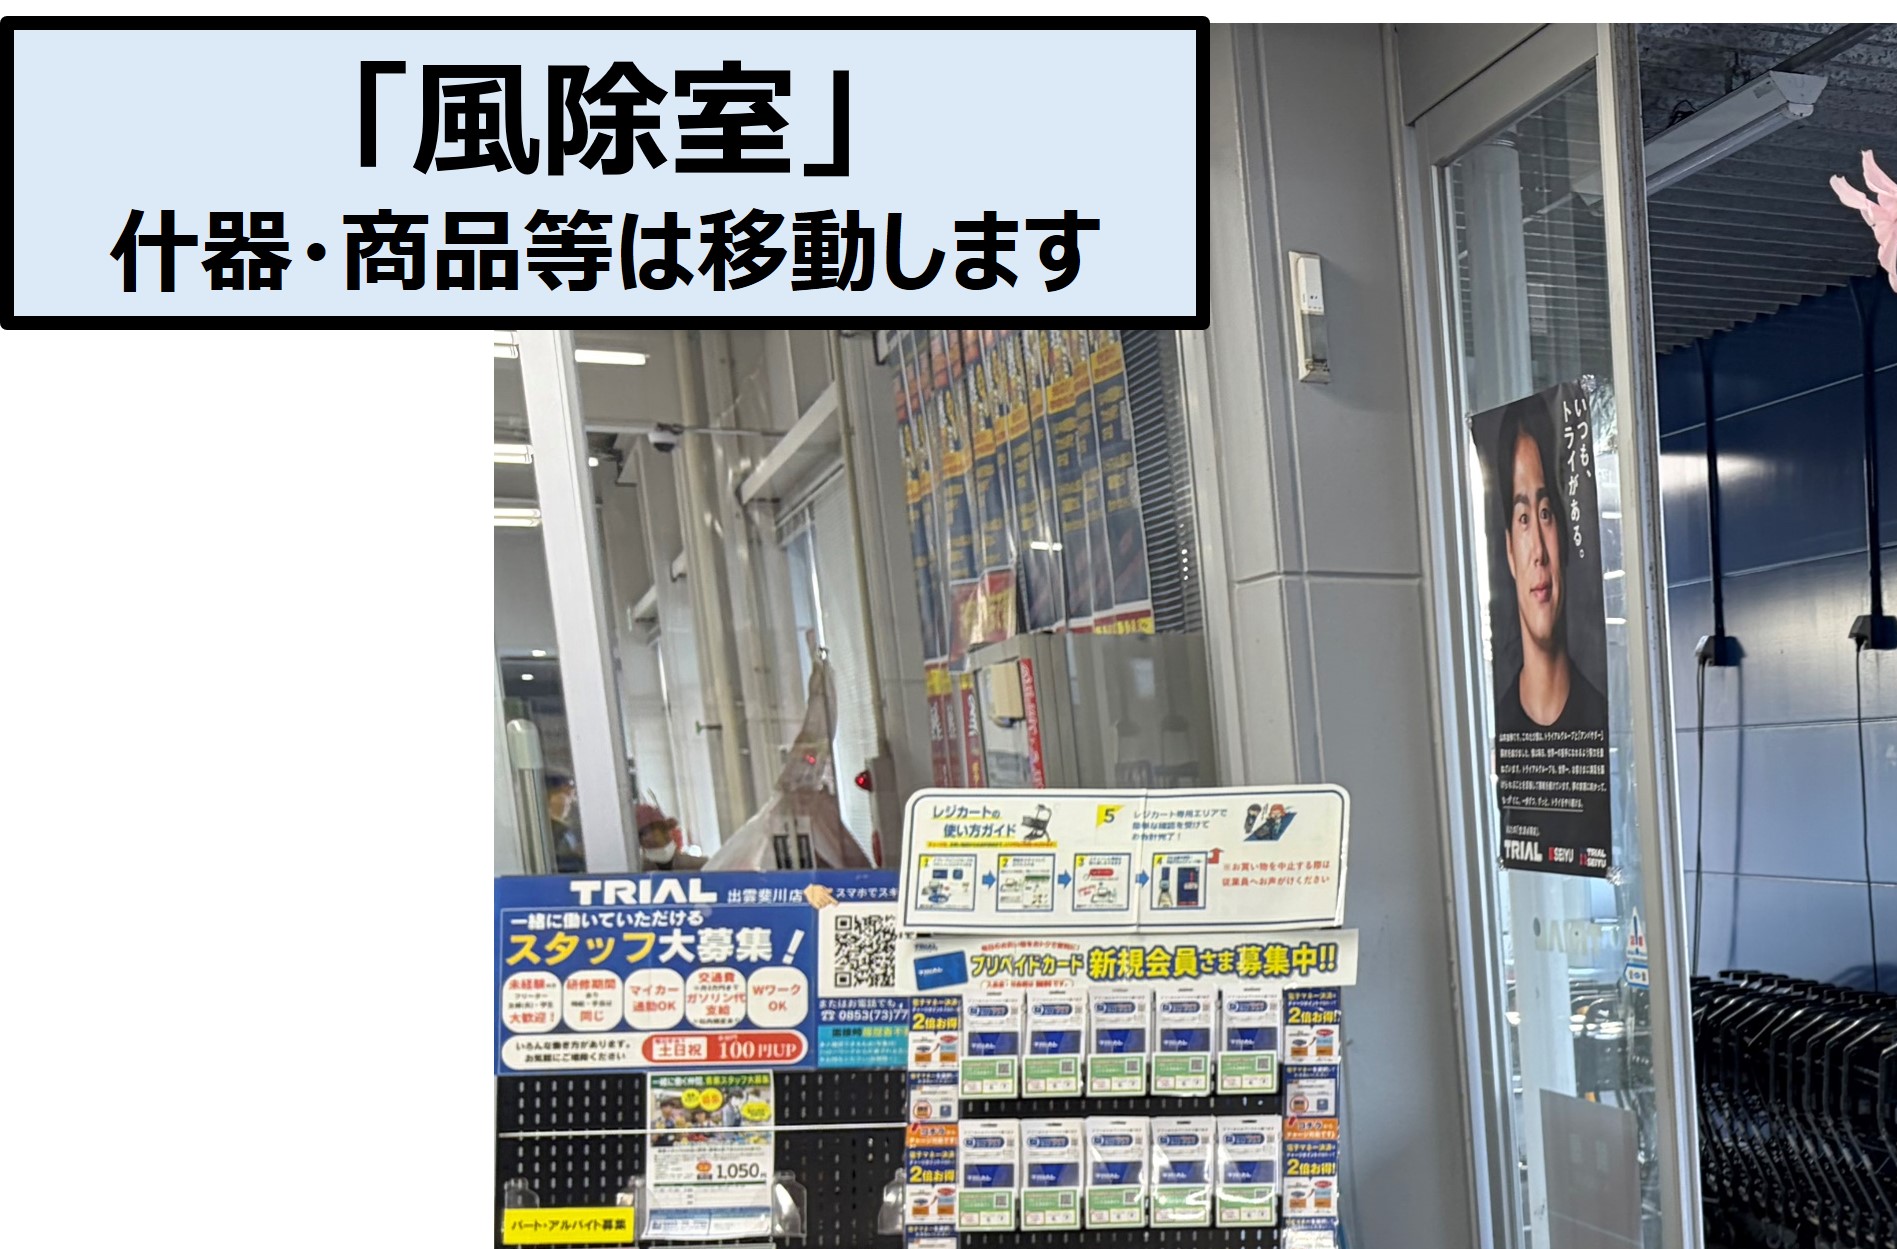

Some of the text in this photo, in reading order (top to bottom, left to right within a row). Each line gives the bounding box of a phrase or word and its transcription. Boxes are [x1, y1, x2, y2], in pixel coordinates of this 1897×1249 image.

[1574, 398, 1592, 478] いつも、
[1563, 401, 1585, 559] トライがある。
[933, 805, 1000, 820] レジカートの
[1105, 808, 1115, 822] 5
[944, 824, 1017, 838] 使い方ガイド
[1504, 840, 1543, 862] TRIAL
[570, 878, 718, 905] TRIAL
[727, 888, 803, 904] 出雲斐川店
[510, 908, 704, 931] 一緒に働いていただける
[506, 927, 805, 966] スタッフ大募集！
[971, 942, 1339, 981] プリペイドカード 新規会員さま募集中!!
[698, 971, 735, 983] 交通費
[630, 985, 679, 995] マイカー
[752, 985, 801, 996] Wワーク
[687, 992, 746, 1003] ガソリン代
[633, 1000, 676, 1012] 通勤OK
[706, 1004, 731, 1017] 支給
[768, 1001, 788, 1012] OK
[580, 1011, 604, 1023] 同じ
[657, 1042, 703, 1058] 土日祝
[719, 1040, 797, 1060] 100円UP
[717, 1163, 759, 1181] 1,050
[511, 1219, 626, 1231] パート・アルバイト募集
